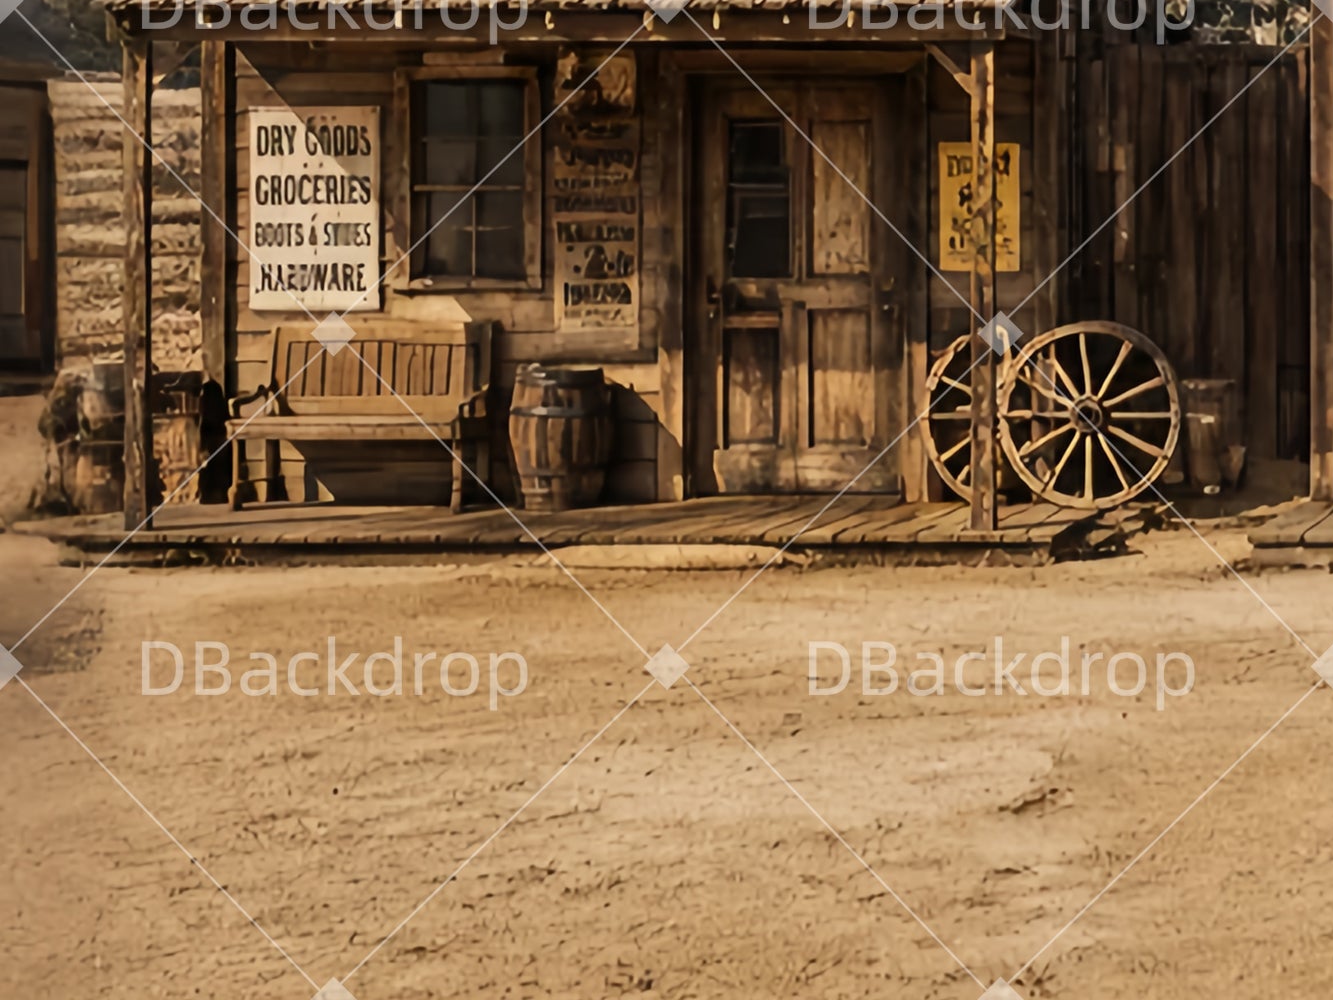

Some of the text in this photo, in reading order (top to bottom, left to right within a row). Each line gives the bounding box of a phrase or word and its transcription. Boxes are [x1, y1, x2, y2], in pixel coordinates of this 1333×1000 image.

[257, 119, 372, 157] DRY GOODS
[255, 174, 371, 205] GROCERIES
